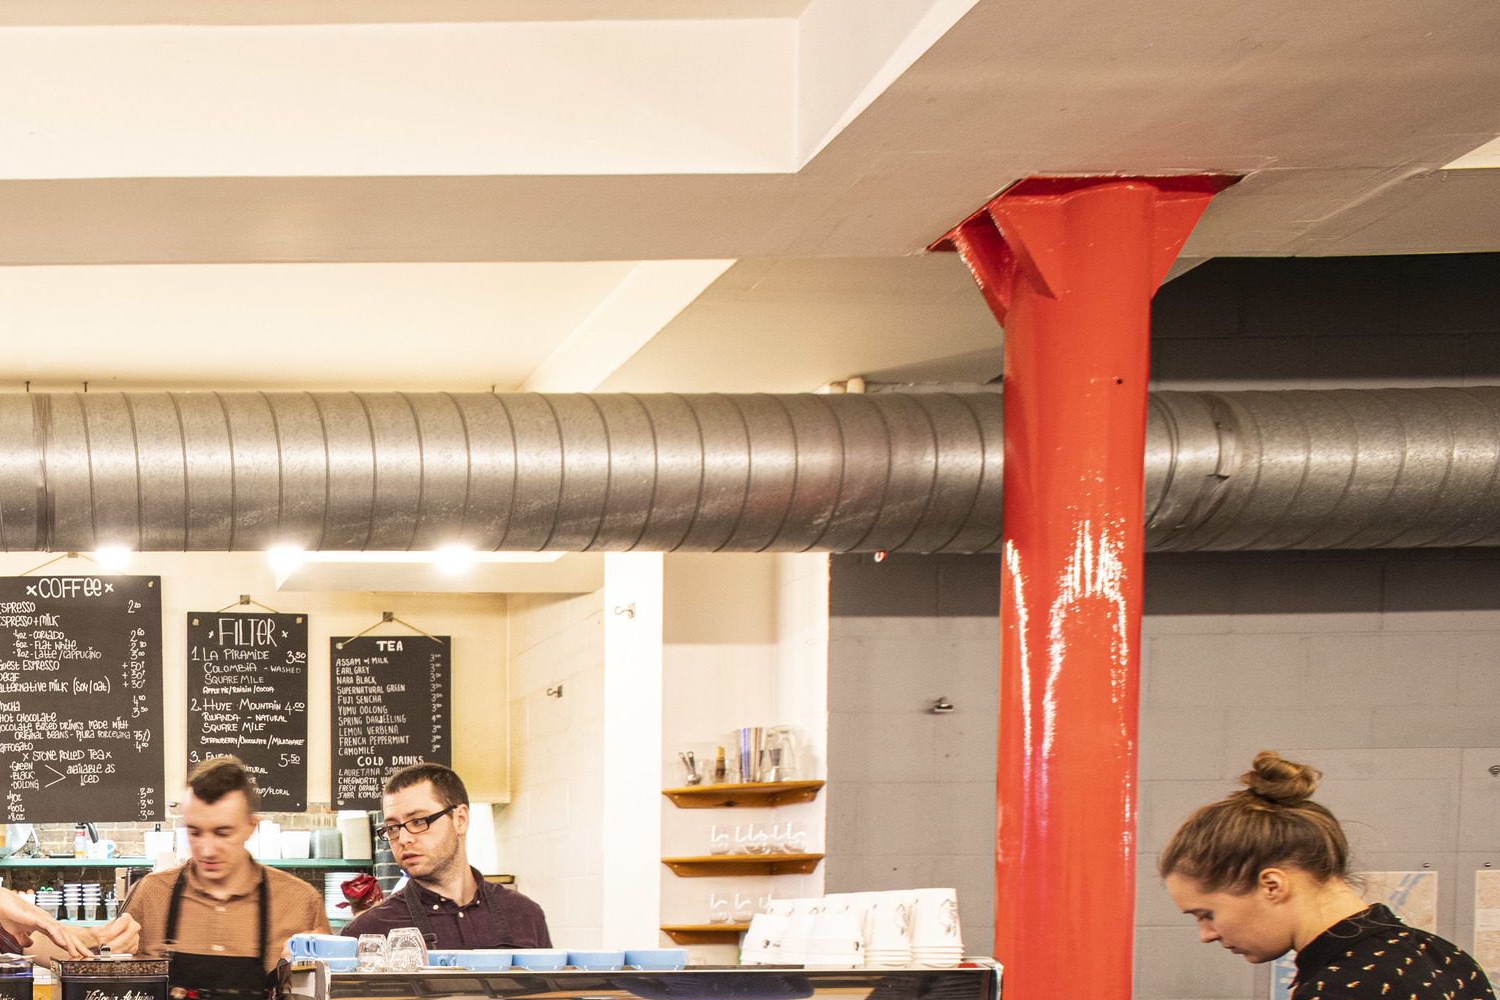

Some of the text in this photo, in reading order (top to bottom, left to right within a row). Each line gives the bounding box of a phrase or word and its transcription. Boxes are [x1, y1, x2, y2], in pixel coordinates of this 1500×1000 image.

[376, 640, 403, 652] TEA
[202, 647, 218, 661] LA
[335, 658, 361, 667] ASSAM
[270, 665, 301, 674] WASHED
[336, 666, 370, 675] EARL GREY
[204, 673, 239, 685] SQUARE
[355, 675, 377, 685] BLACK
[336, 684, 406, 695] SUPERNATURAL GREEN
[203, 699, 233, 711] HUYE
[337, 694, 382, 705] FUJI SENCHA
[359, 705, 388, 715] OOLONG
[201, 712, 288, 722] RWANDA NATURAL
[338, 714, 407, 727] SPRING DARJEELING
[201, 722, 238, 733] SQUARE
[338, 725, 399, 737] LEMON VERBENA
[339, 735, 410, 747] FRENCH PEPPERMINT
[338, 746, 375, 756] CAMOMILE
[357, 756, 424, 767] COLD DRINKS
[338, 767, 381, 777] LAURETANA
[338, 777, 380, 785] CHEGWORTH
[338, 784, 380, 792] FRESH ORANGE
